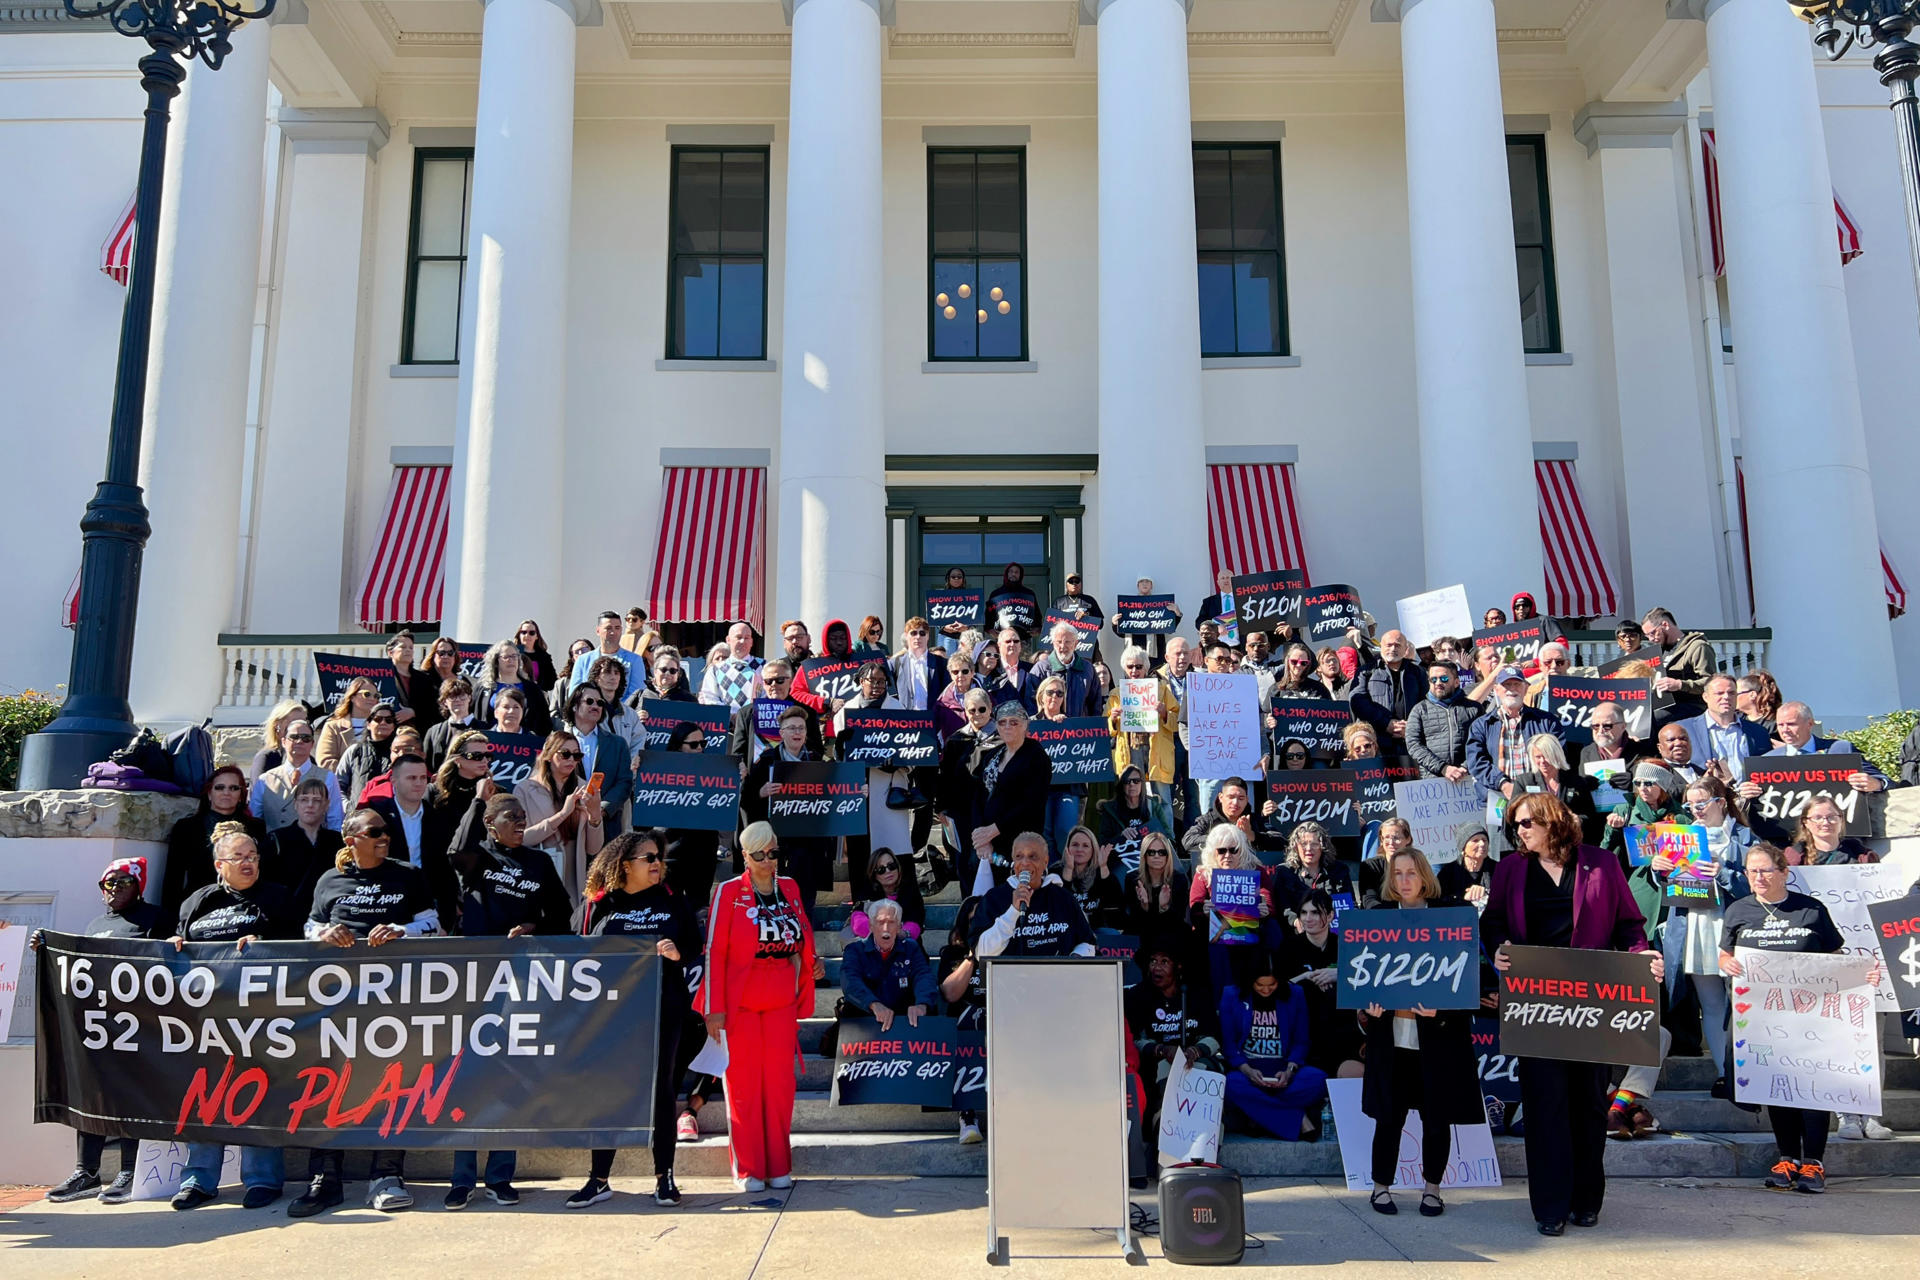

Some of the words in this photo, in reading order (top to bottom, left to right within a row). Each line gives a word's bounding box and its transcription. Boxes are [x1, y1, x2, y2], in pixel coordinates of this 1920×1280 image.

[1236, 584, 1269, 596] SHOW
[1272, 582, 1285, 591] US
[1286, 580, 1303, 590] THE
[930, 604, 978, 620] $120M
[1129, 611, 1145, 619] WHO
[1148, 610, 1164, 618] CAN
[1242, 595, 1302, 623] $120M
[1321, 603, 1342, 616] WHO
[1120, 620, 1149, 629] AFFORD
[1150, 619, 1172, 628] THAT?
[1313, 617, 1350, 634] AFFORD
[1476, 633, 1504, 647] SHOW
[1506, 631, 1519, 640] US
[1520, 628, 1540, 638] THE
[318, 662, 394, 677] $4,216/MONTH
[807, 662, 842, 680] SHOW
[844, 661, 859, 669] US
[1125, 683, 1154, 695] TRUMP
[1552, 687, 1595, 700] SHOW
[1597, 690, 1616, 700] US
[1618, 690, 1647, 700] THE
[758, 703, 770, 711] WE
[1123, 697, 1139, 706] HAS
[1142, 695, 1156, 706] NO
[1192, 697, 1241, 714] LIVES
[758, 711, 777, 720] NOT
[1273, 707, 1350, 720] $4,216/MONTH
[1557, 700, 1645, 732] $12M
[846, 718, 933, 729] $4,216/MONTH
[1193, 720, 1217, 730] ARE
[1222, 720, 1239, 729] AT
[1288, 721, 1312, 734] WHO
[1315, 722, 1338, 735] CAN
[864, 732, 890, 744] WHO
[894, 731, 920, 744] CAN
[1192, 735, 1248, 750] STAKE
[513, 745, 531, 756] US
[849, 747, 896, 760] AFFORD
[899, 746, 934, 759] THAT?
[1071, 741, 1096, 756] CAN
[1208, 750, 1238, 760] SAVE
[1075, 758, 1109, 774] THAT?
[1191, 760, 1251, 775] ADAP
[640, 772, 696, 786] WHERE
[699, 776, 737, 789] WILL
[1750, 771, 1800, 784] SHOW
[1803, 770, 1827, 782] US
[1830, 769, 1858, 781] THE
[778, 783, 823, 795] WHERE
[827, 783, 862, 794] WILL
[1271, 783, 1310, 793] SHOW
[1311, 783, 1327, 792] US
[1329, 782, 1353, 792] THE
[1364, 782, 1390, 798] WHO
[636, 789, 702, 807] PATIENTS
[707, 793, 736, 807] GO?
[772, 799, 832, 816] PATIENTS
[836, 798, 864, 815] GO?
[1276, 795, 1352, 826] $120M
[1360, 799, 1397, 815] FFORD
[1413, 805, 1431, 820] ARE
[1437, 802, 1449, 817] AT
[1663, 832, 1699, 846] PRIDE
[1667, 844, 1701, 854] CAPITOL
[483, 869, 517, 887] FLORIDA
[518, 879, 540, 891] ADAP
[1217, 875, 1232, 883] WE
[1233, 875, 1256, 884] WILL
[356, 884, 382, 895] SAVE
[1216, 884, 1238, 893] NOT
[1241, 885, 1256, 895] BE
[336, 894, 375, 905] FLORIDA
[377, 893, 404, 904] ADAP
[1216, 894, 1256, 905] ERASED
[210, 906, 235, 918] SAVE
[648, 912, 671, 922] ADAP
[1028, 912, 1049, 924] SAVE
[189, 917, 227, 931] FLORIDA
[228, 914, 256, 925] ADAP
[1763, 919, 1790, 930] SAVE
[1881, 917, 1920, 938] SHO
[1012, 925, 1046, 938] FLORIDA
[1048, 923, 1069, 934] ADAP
[1344, 928, 1401, 943] SHOW
[1407, 928, 1431, 942] US
[1434, 926, 1473, 941] THE
[1741, 928, 1784, 939] FLORIDA
[1785, 928, 1812, 938] ADAP
[1347, 944, 1469, 994] $120M
[1745, 953, 1839, 993] Reducing
[57, 955, 216, 1009] 16,000
[238, 958, 619, 1007] FLORIDIANS.
[1505, 976, 1589, 999] WHERE
[1595, 983, 1655, 1004] WILL
[1764, 988, 1870, 1028] ADAP
[1503, 1002, 1604, 1029] PATIENTS
[1610, 1009, 1656, 1033] GO?
[83, 1010, 140, 1052] 52
[161, 1015, 297, 1058] DAYS
[319, 1012, 556, 1059] NOTICE.
[1804, 1030, 1823, 1042] a
[841, 1041, 903, 1056] WHERE
[908, 1041, 951, 1056] WILL
[836, 1059, 912, 1082] PATIENTS
[916, 1062, 951, 1080] GO?
[174, 1054, 269, 1135] NO
[287, 1048, 466, 1140] PLAN.
[1162, 1119, 1197, 1142] SAVE
[1193, 1207, 1217, 1224] JBL
